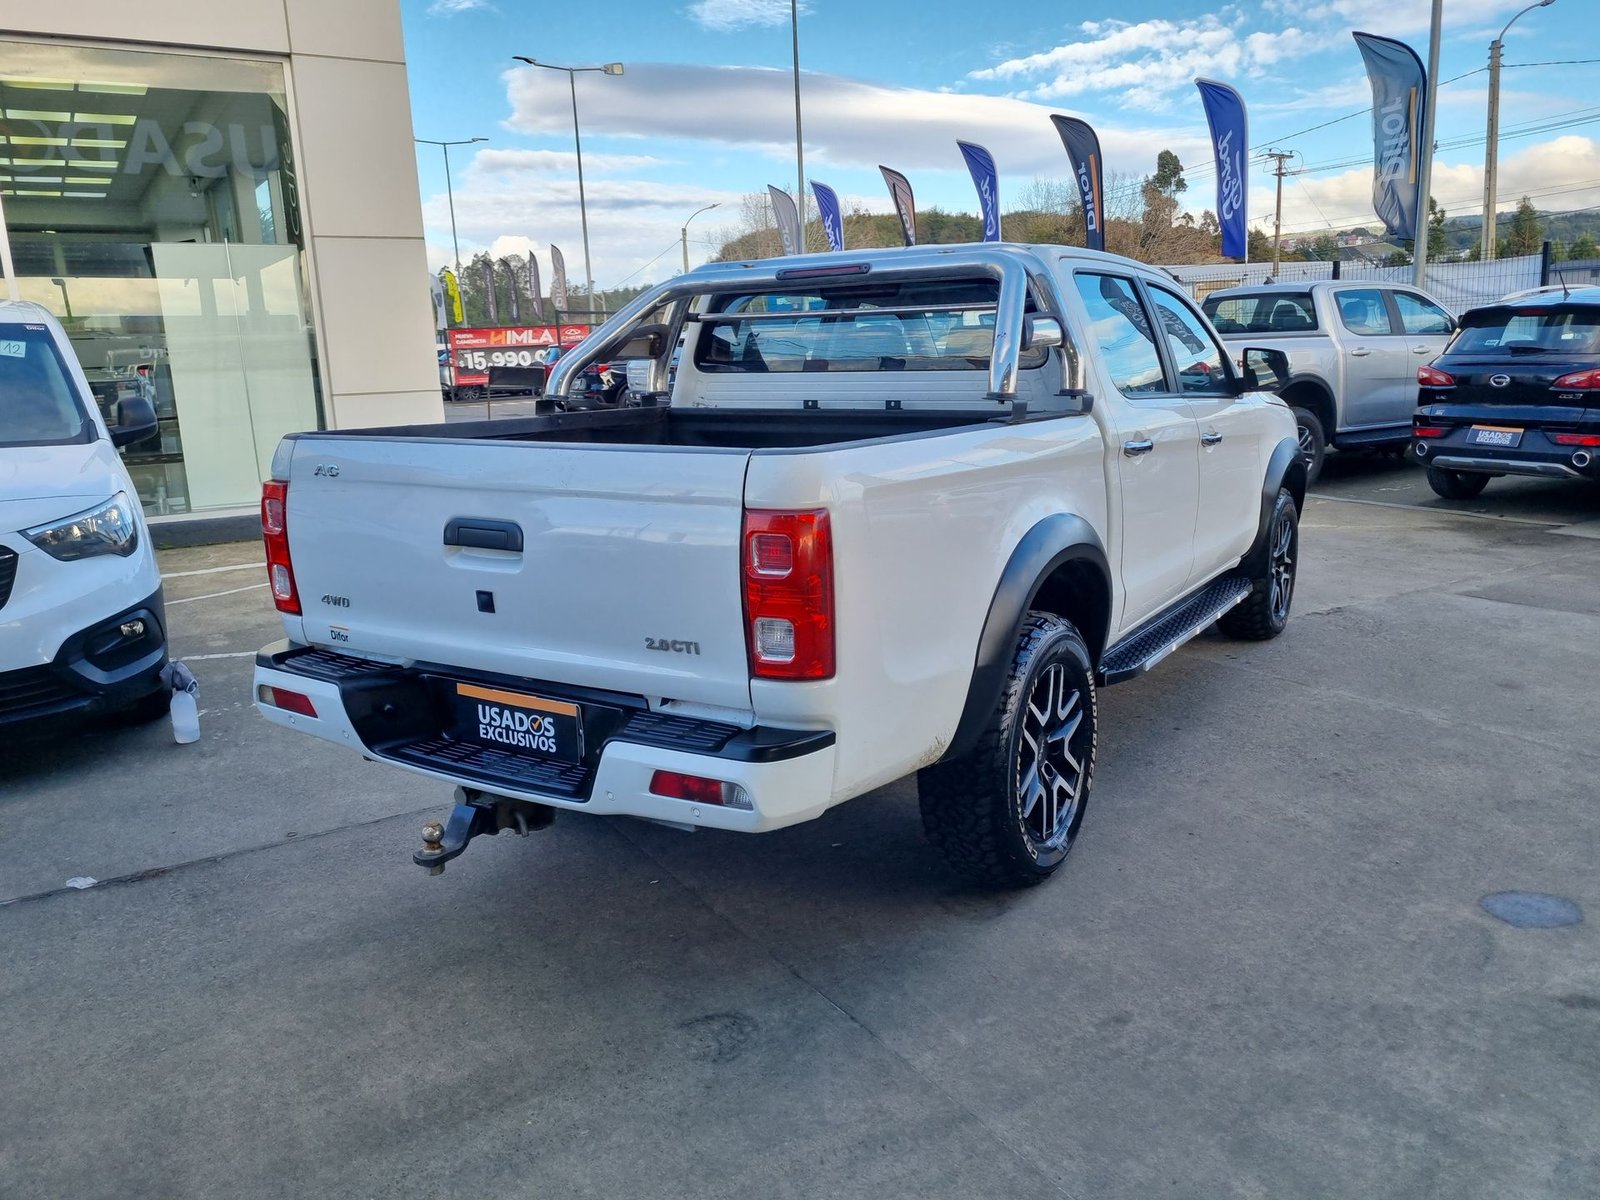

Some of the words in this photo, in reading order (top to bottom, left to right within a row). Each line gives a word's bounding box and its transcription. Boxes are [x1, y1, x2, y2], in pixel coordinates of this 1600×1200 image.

[1478, 430, 1513, 440] USADOS
[321, 594, 350, 608] 4WD
[330, 629, 349, 642] Difor
[477, 703, 556, 737] USADOS
[479, 723, 557, 753] EXCLUSIVOS
